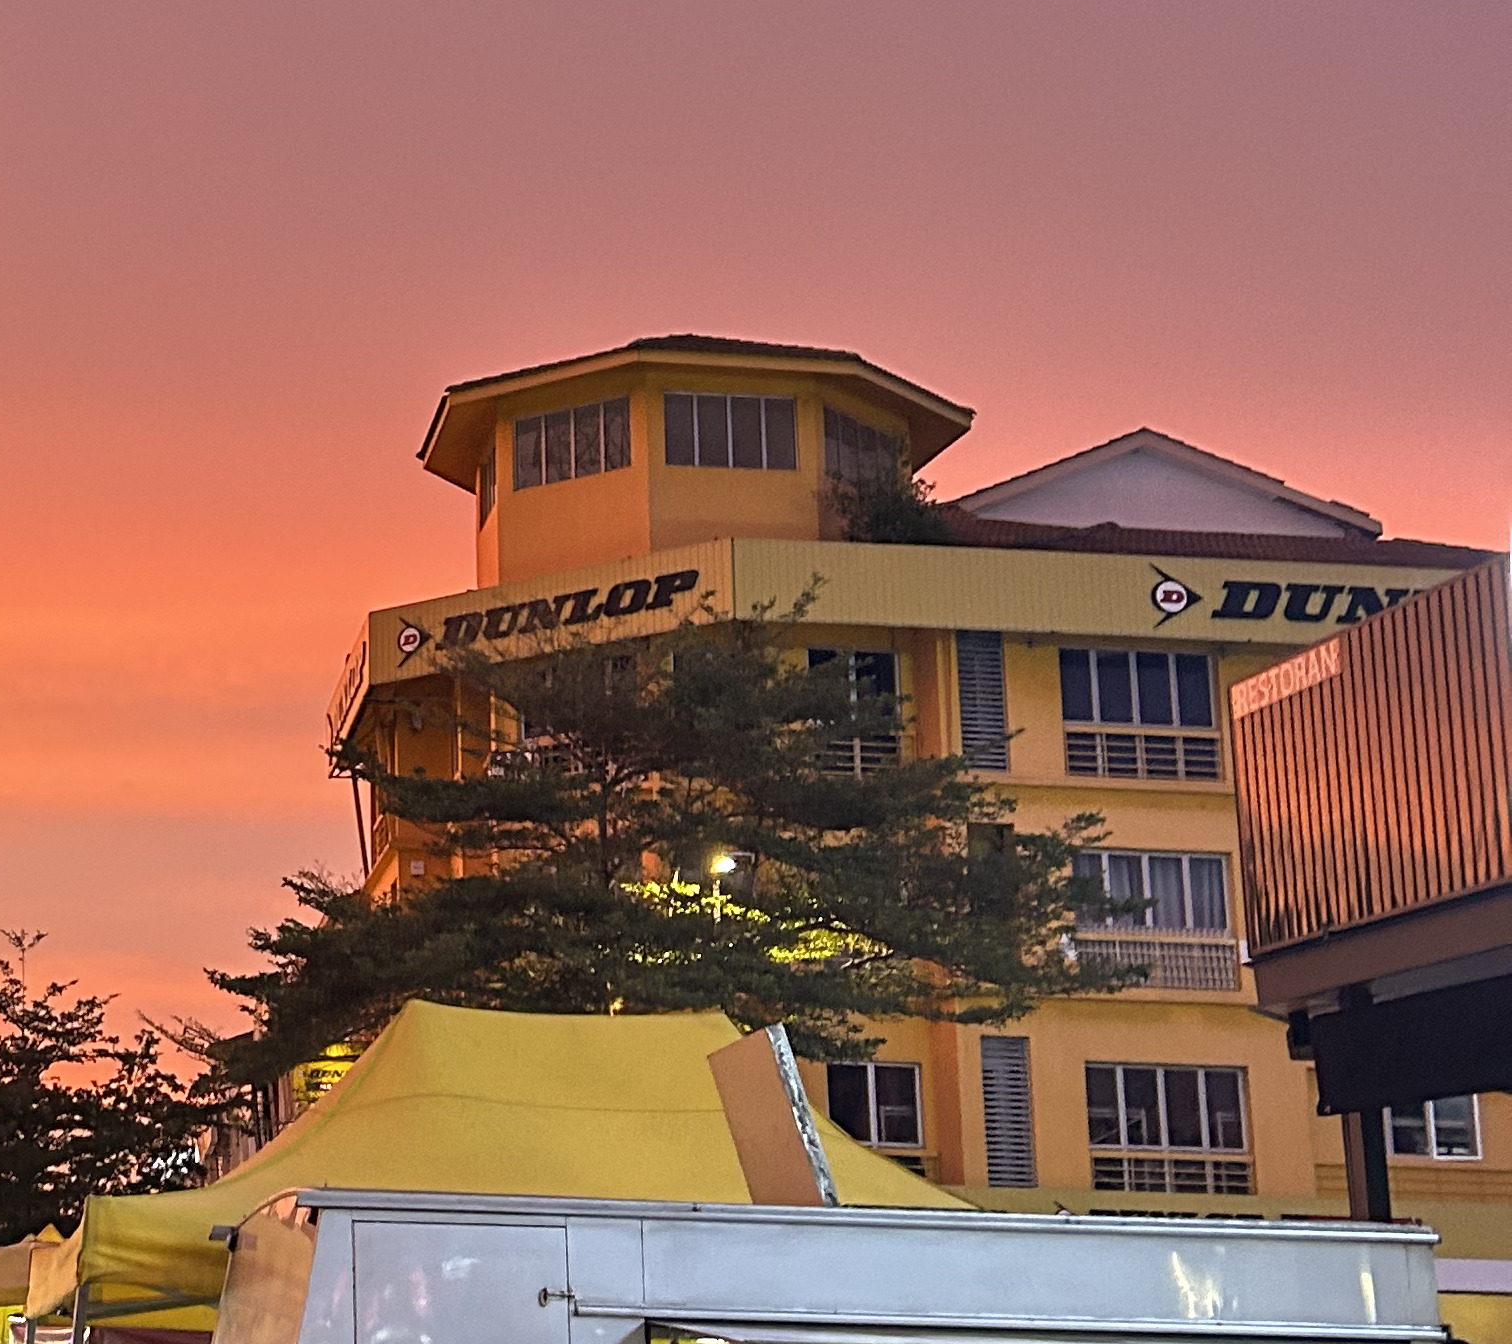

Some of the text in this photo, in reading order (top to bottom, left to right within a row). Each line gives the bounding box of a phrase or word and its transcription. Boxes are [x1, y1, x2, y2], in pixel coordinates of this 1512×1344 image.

[435, 569, 699, 651] DUNLOP
[1211, 580, 1426, 624] DUN
[1231, 638, 1340, 718] RESTORAN
